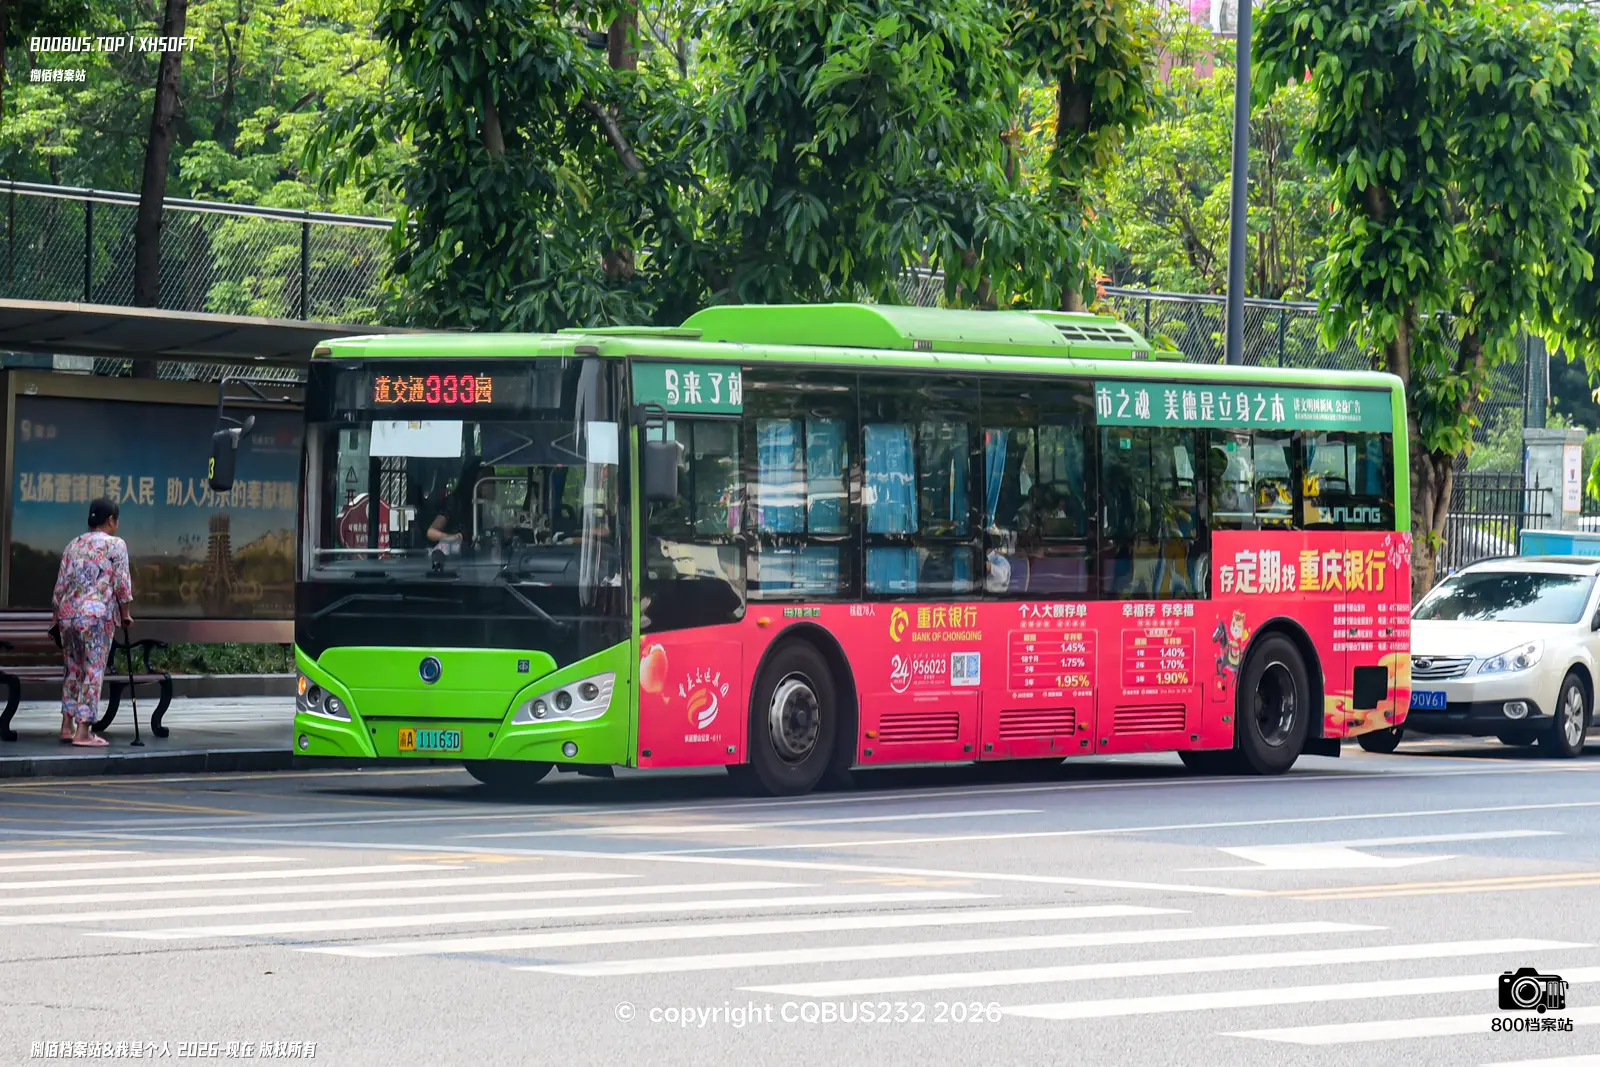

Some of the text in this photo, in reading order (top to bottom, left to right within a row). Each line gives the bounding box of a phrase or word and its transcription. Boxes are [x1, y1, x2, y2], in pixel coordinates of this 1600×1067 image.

[1164, 390, 1285, 422] 美德是立身之本
[917, 606, 977, 628] 重庆银行
[1018, 604, 1087, 618] 个人大额存单
[912, 630, 982, 642] BANK OF CHONGQING
[1061, 643, 1085, 653] 1.45%
[1160, 648, 1185, 657] 1.40%
[913, 659, 946, 675] 956023
[1061, 657, 1085, 667] 1.75%
[1160, 660, 1185, 670] 1.70%
[1055, 674, 1090, 688] 1.95%
[1156, 672, 1189, 685] 1.90%
